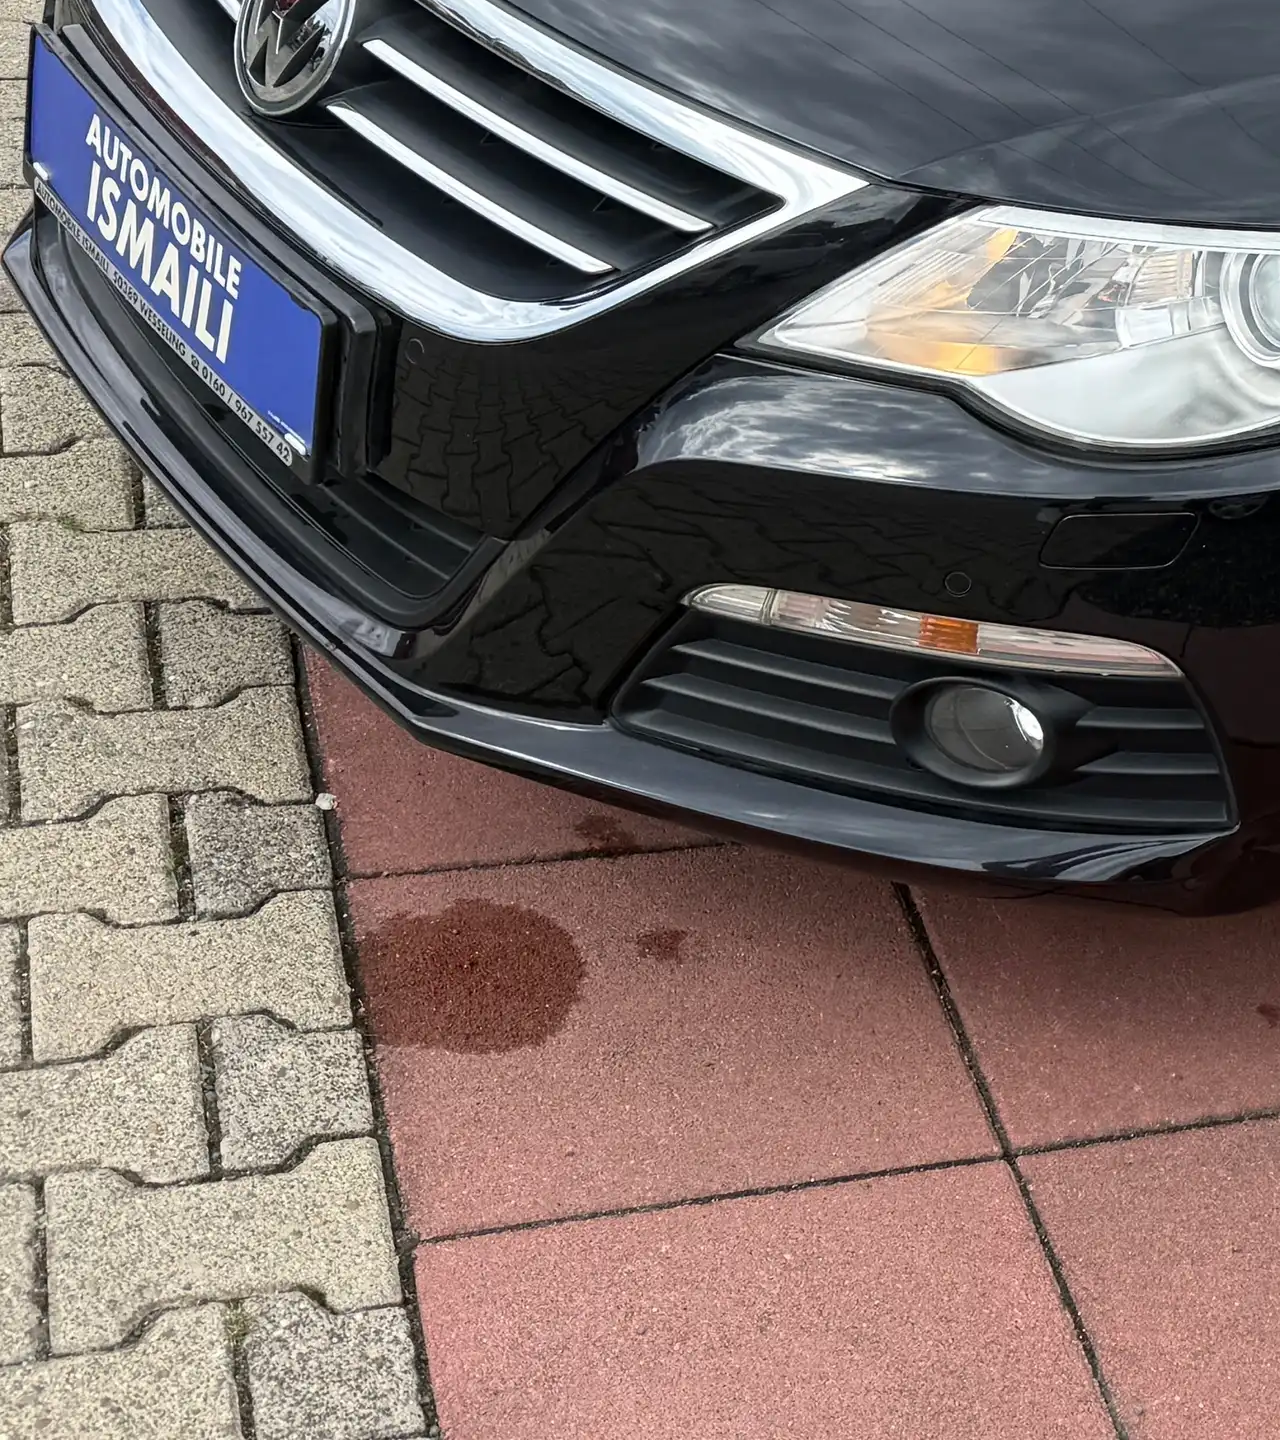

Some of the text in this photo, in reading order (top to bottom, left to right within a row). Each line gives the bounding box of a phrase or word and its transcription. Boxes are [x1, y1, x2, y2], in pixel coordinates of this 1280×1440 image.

[85, 114, 242, 299] AUTOMOBILE
[86, 160, 234, 364] ISMAILI
[36, 181, 82, 241] AUTOMOBILE
[81, 237, 109, 273] ISMAILI
[113, 272, 139, 305] 50389
[140, 299, 186, 357] WESSELING
[202, 365, 226, 396] 0160
[235, 399, 254, 424] 967
[255, 421, 274, 444] 557
[276, 442, 290, 462] 42
